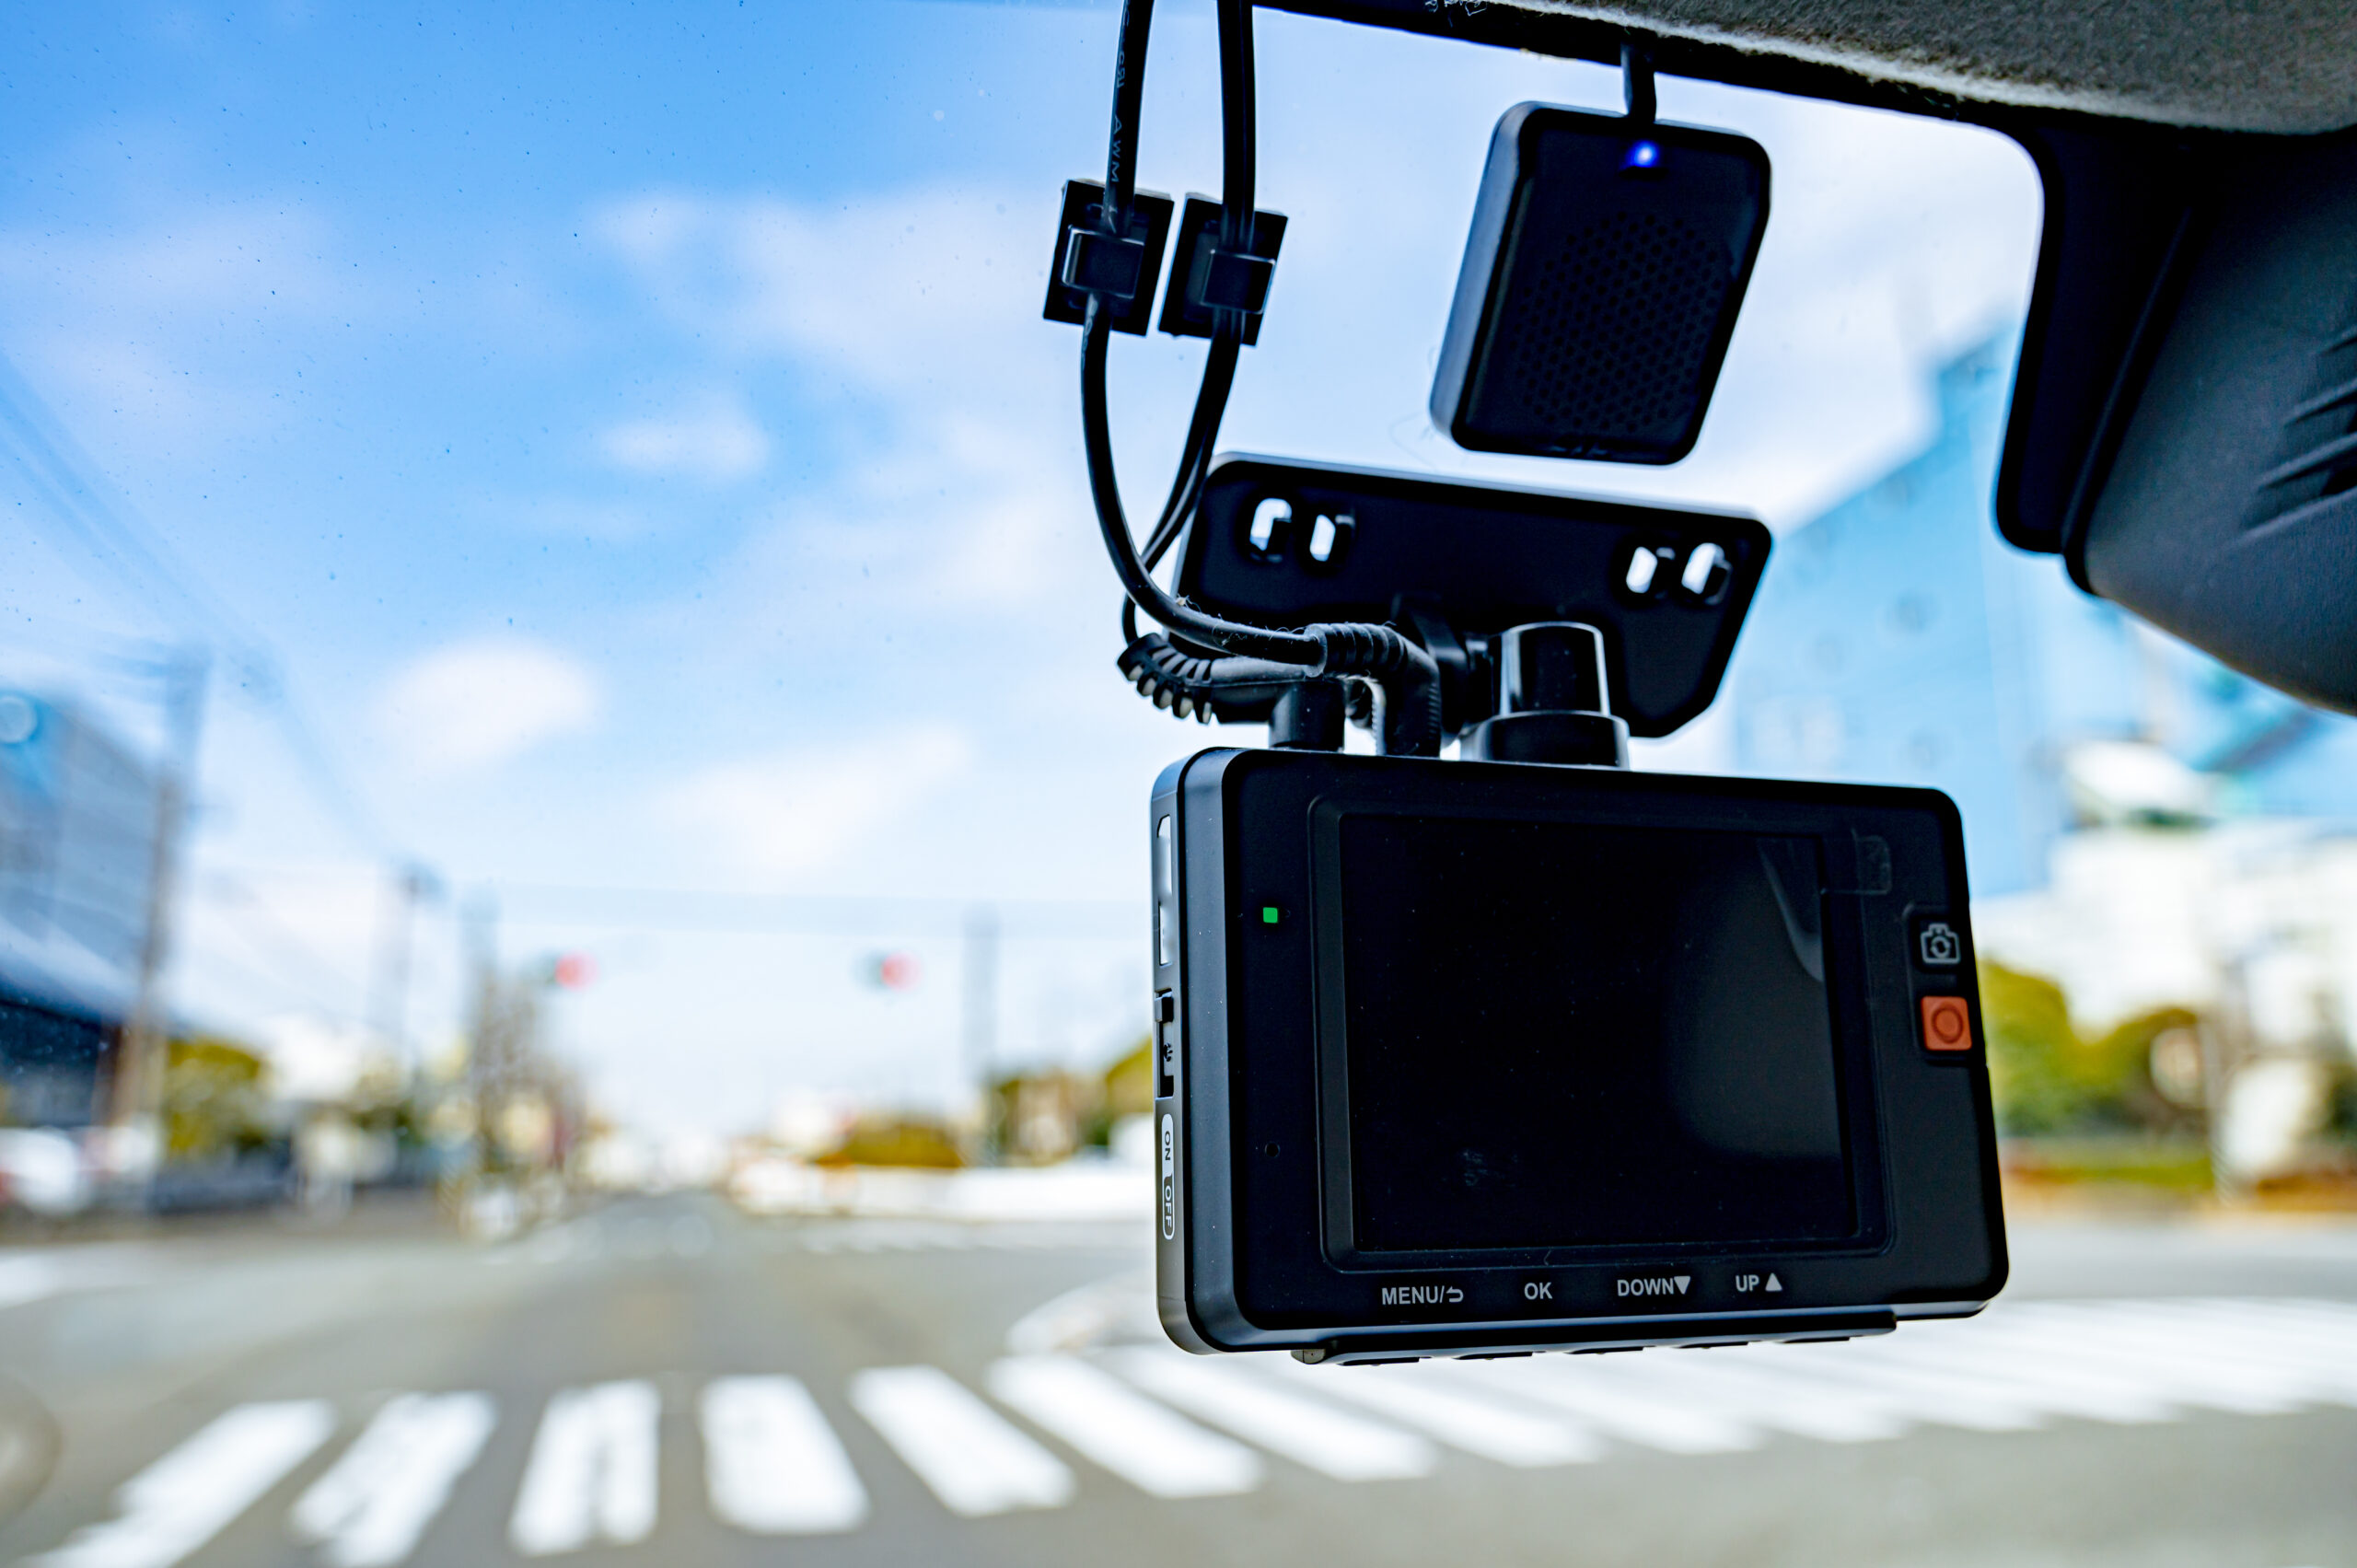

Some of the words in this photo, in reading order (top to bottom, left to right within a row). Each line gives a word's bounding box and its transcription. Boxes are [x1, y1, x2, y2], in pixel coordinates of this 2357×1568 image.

[1110, 114, 1123, 183] AWM
[1165, 1131, 1171, 1161] ON
[1524, 1282, 1553, 1300] OK
[1617, 1278, 1674, 1296] DOWN
[1735, 1274, 1759, 1293] UP
